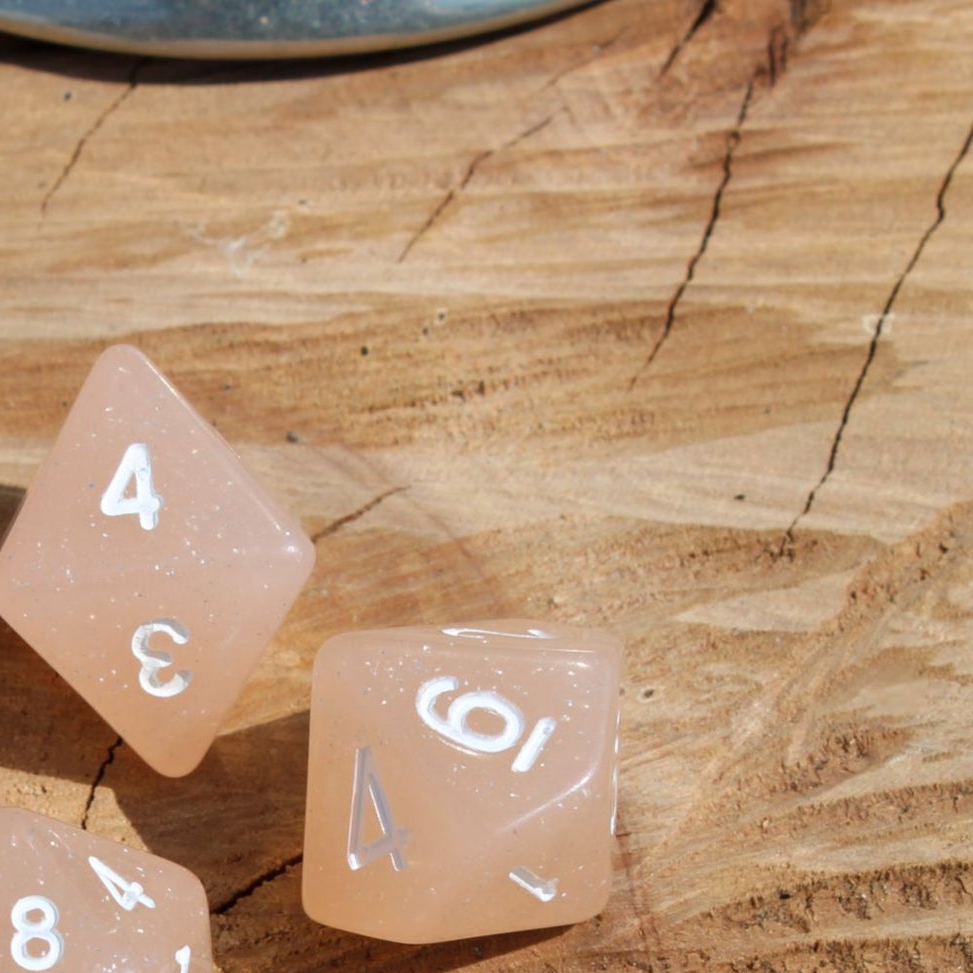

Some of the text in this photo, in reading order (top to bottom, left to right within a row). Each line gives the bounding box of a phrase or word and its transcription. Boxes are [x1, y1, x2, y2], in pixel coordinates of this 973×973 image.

[100, 443, 164, 531] 4
[131, 617, 193, 698] 3
[415, 675, 557, 772] 6
[347, 747, 410, 872] 4
[88, 856, 157, 911] 4
